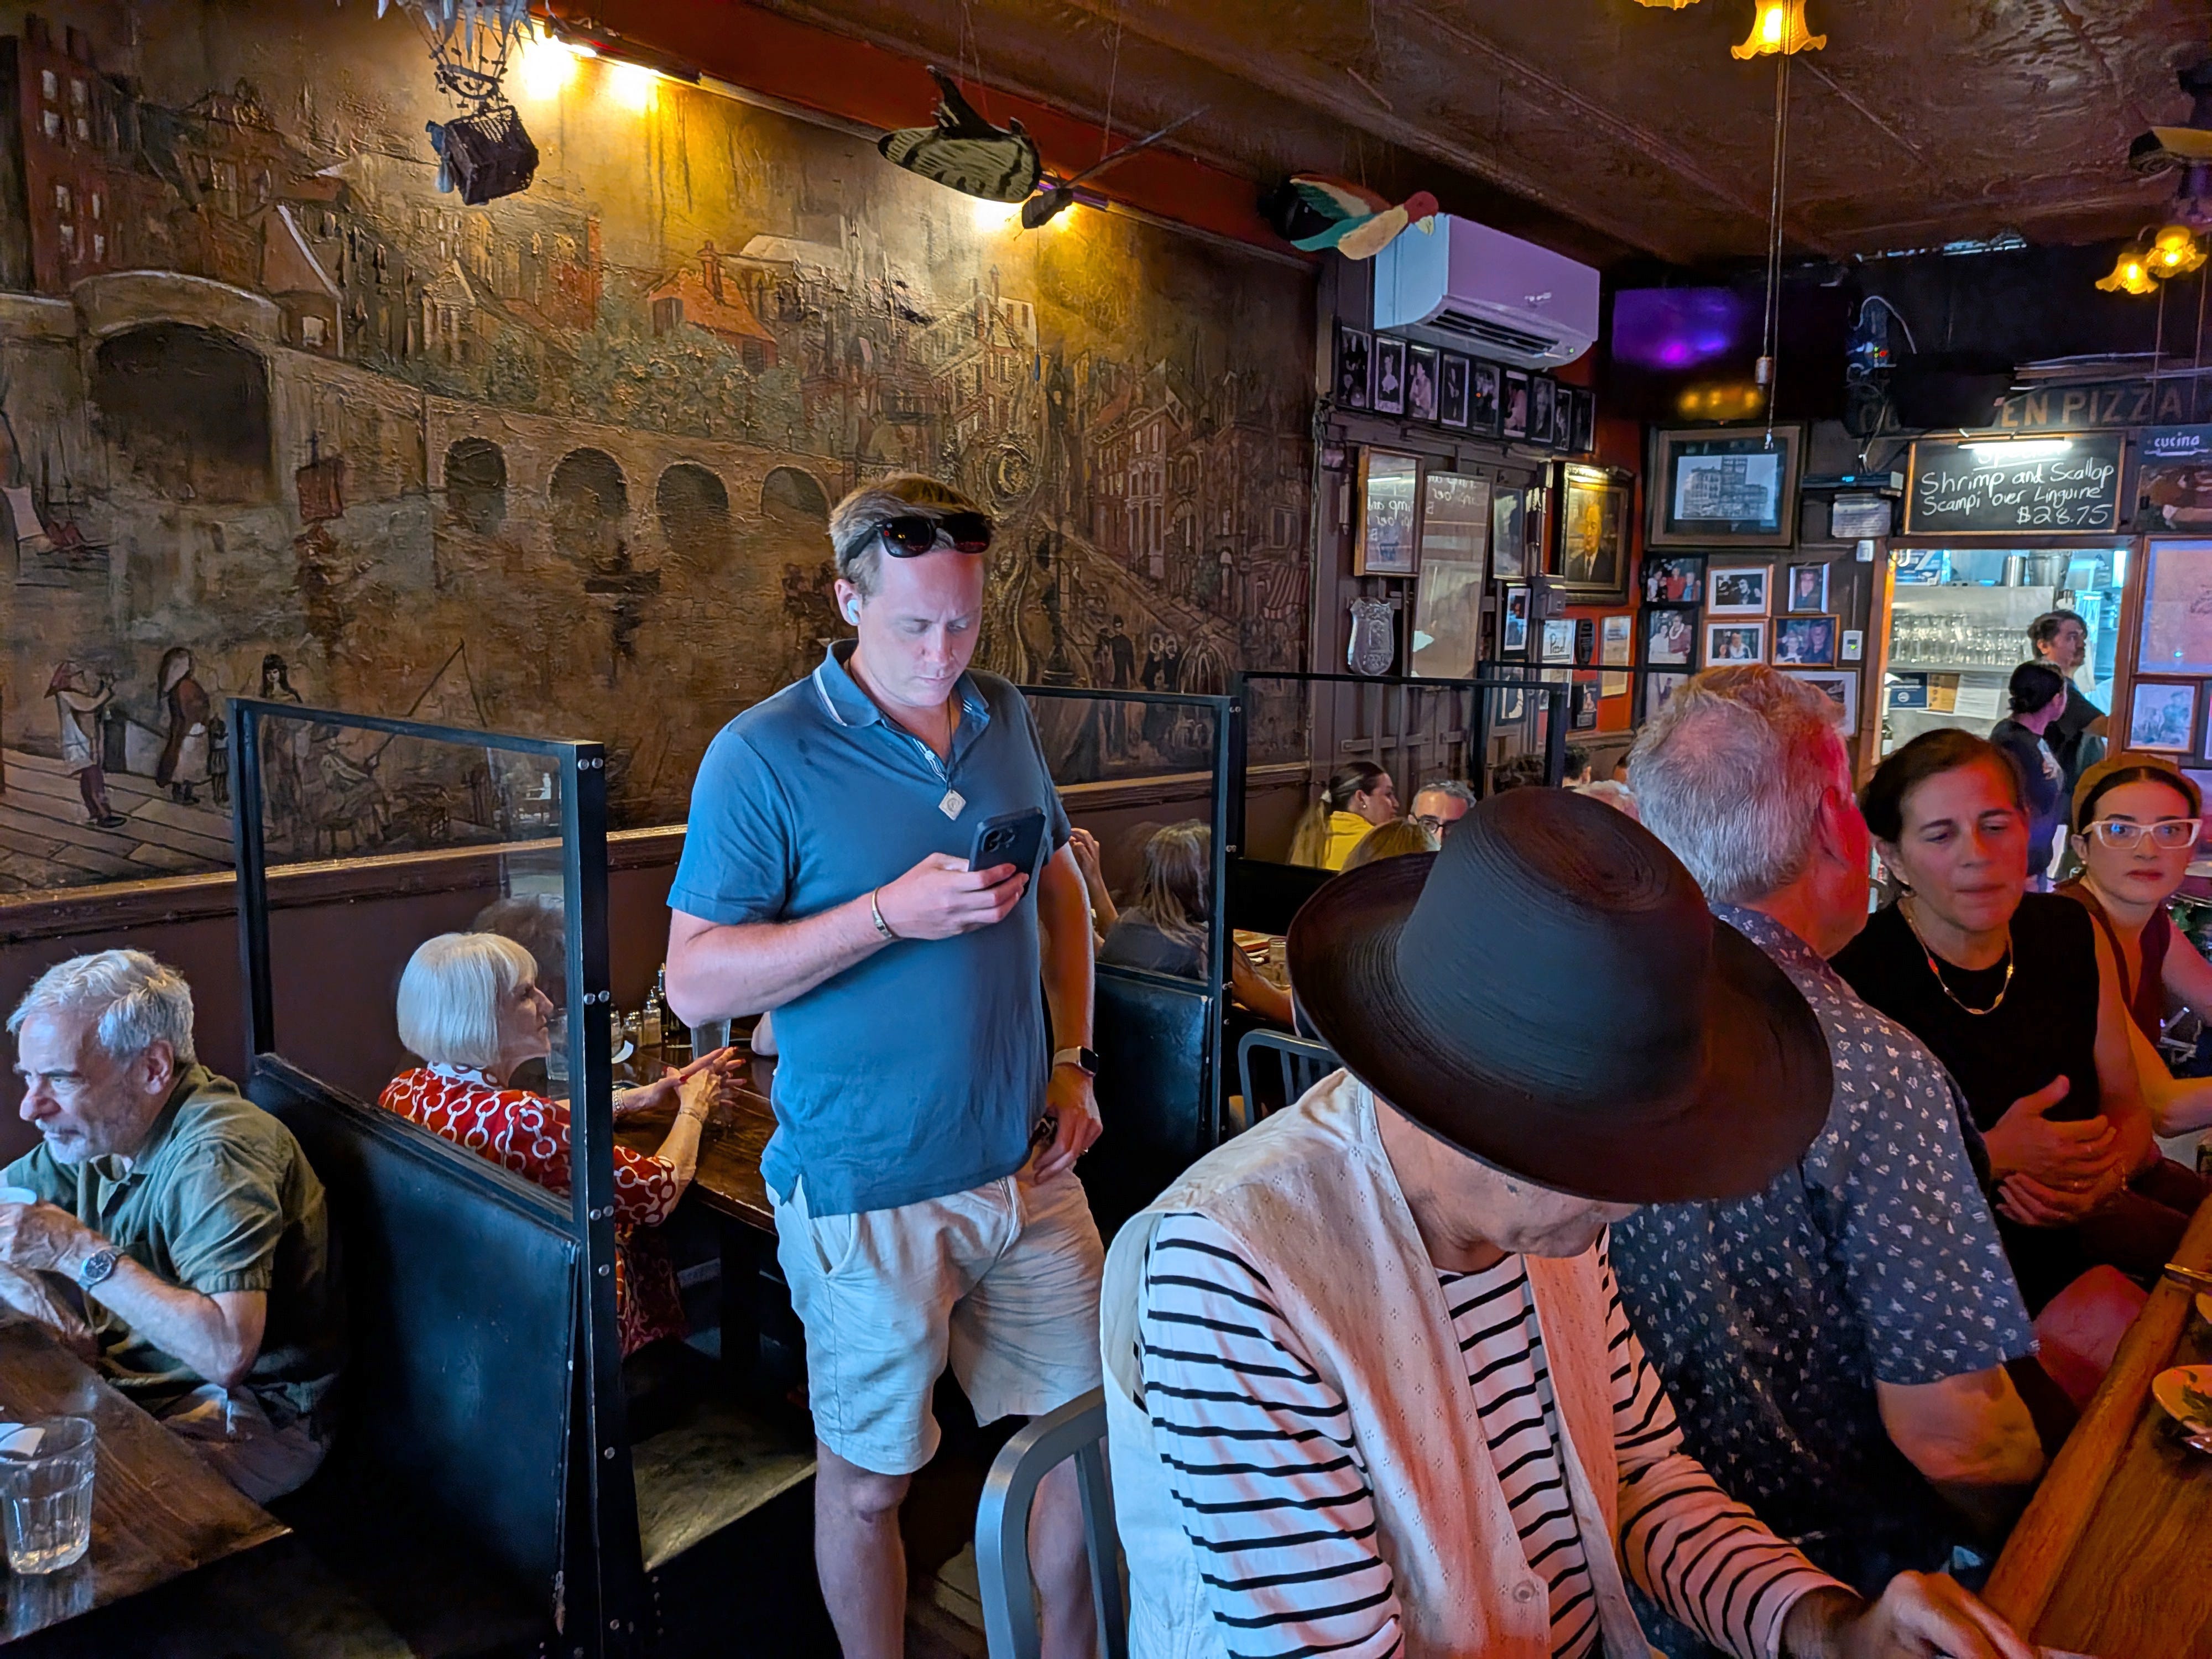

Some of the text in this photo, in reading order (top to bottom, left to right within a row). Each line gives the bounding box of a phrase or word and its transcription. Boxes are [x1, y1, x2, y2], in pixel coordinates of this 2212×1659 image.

[2001, 393, 2047, 427] EN
[2062, 388, 2182, 425] PIZZA
[2153, 432, 2200, 448] cucina
[1920, 457, 2115, 499] Shrimp and Scallop
[1922, 486, 2102, 516] Scampi over Linguine
[2016, 504, 2114, 525] $28.75
